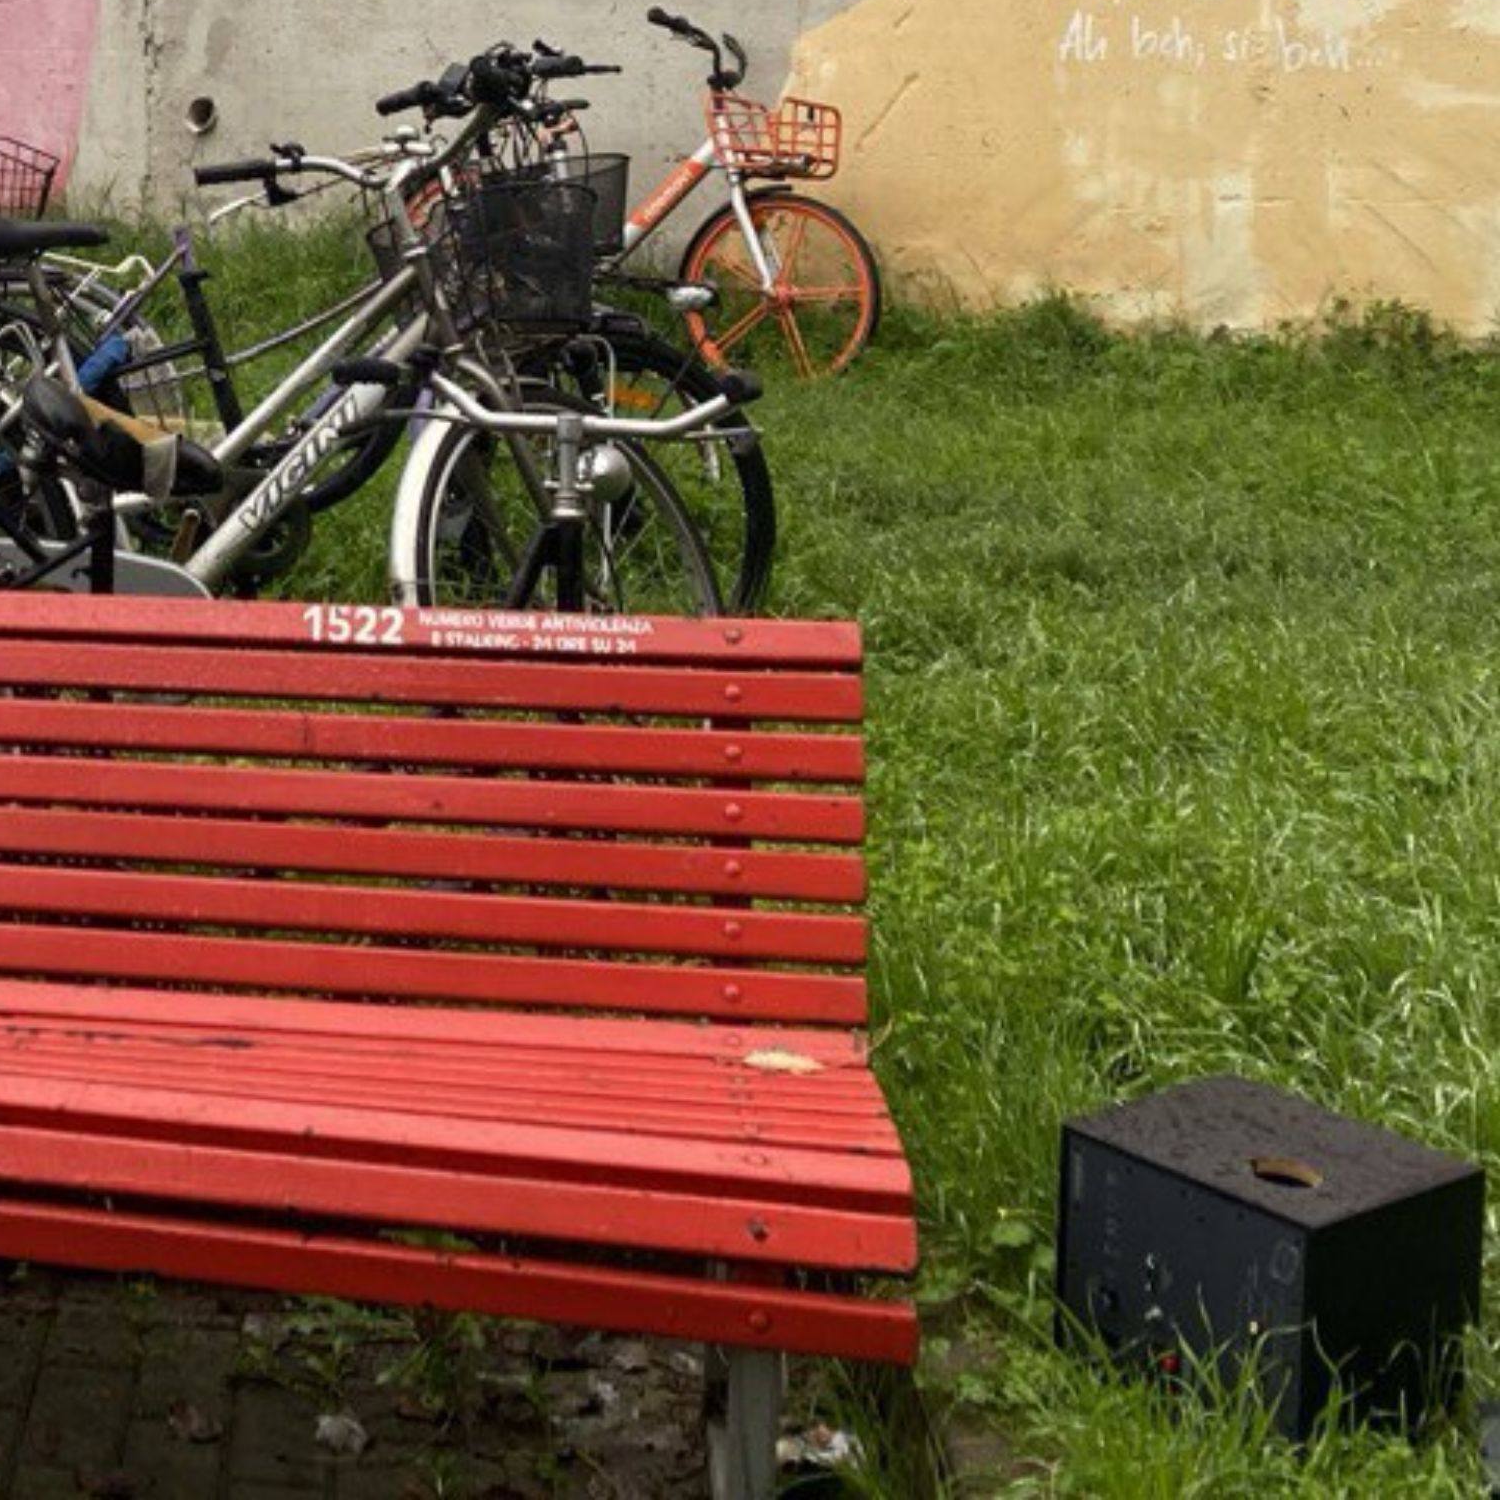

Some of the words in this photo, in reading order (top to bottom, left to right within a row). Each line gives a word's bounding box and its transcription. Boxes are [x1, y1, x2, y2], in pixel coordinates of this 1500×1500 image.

[1059, 9, 1109, 62] Ah
[301, 604, 405, 644] 1522
[418, 609, 484, 630] NUMERO
